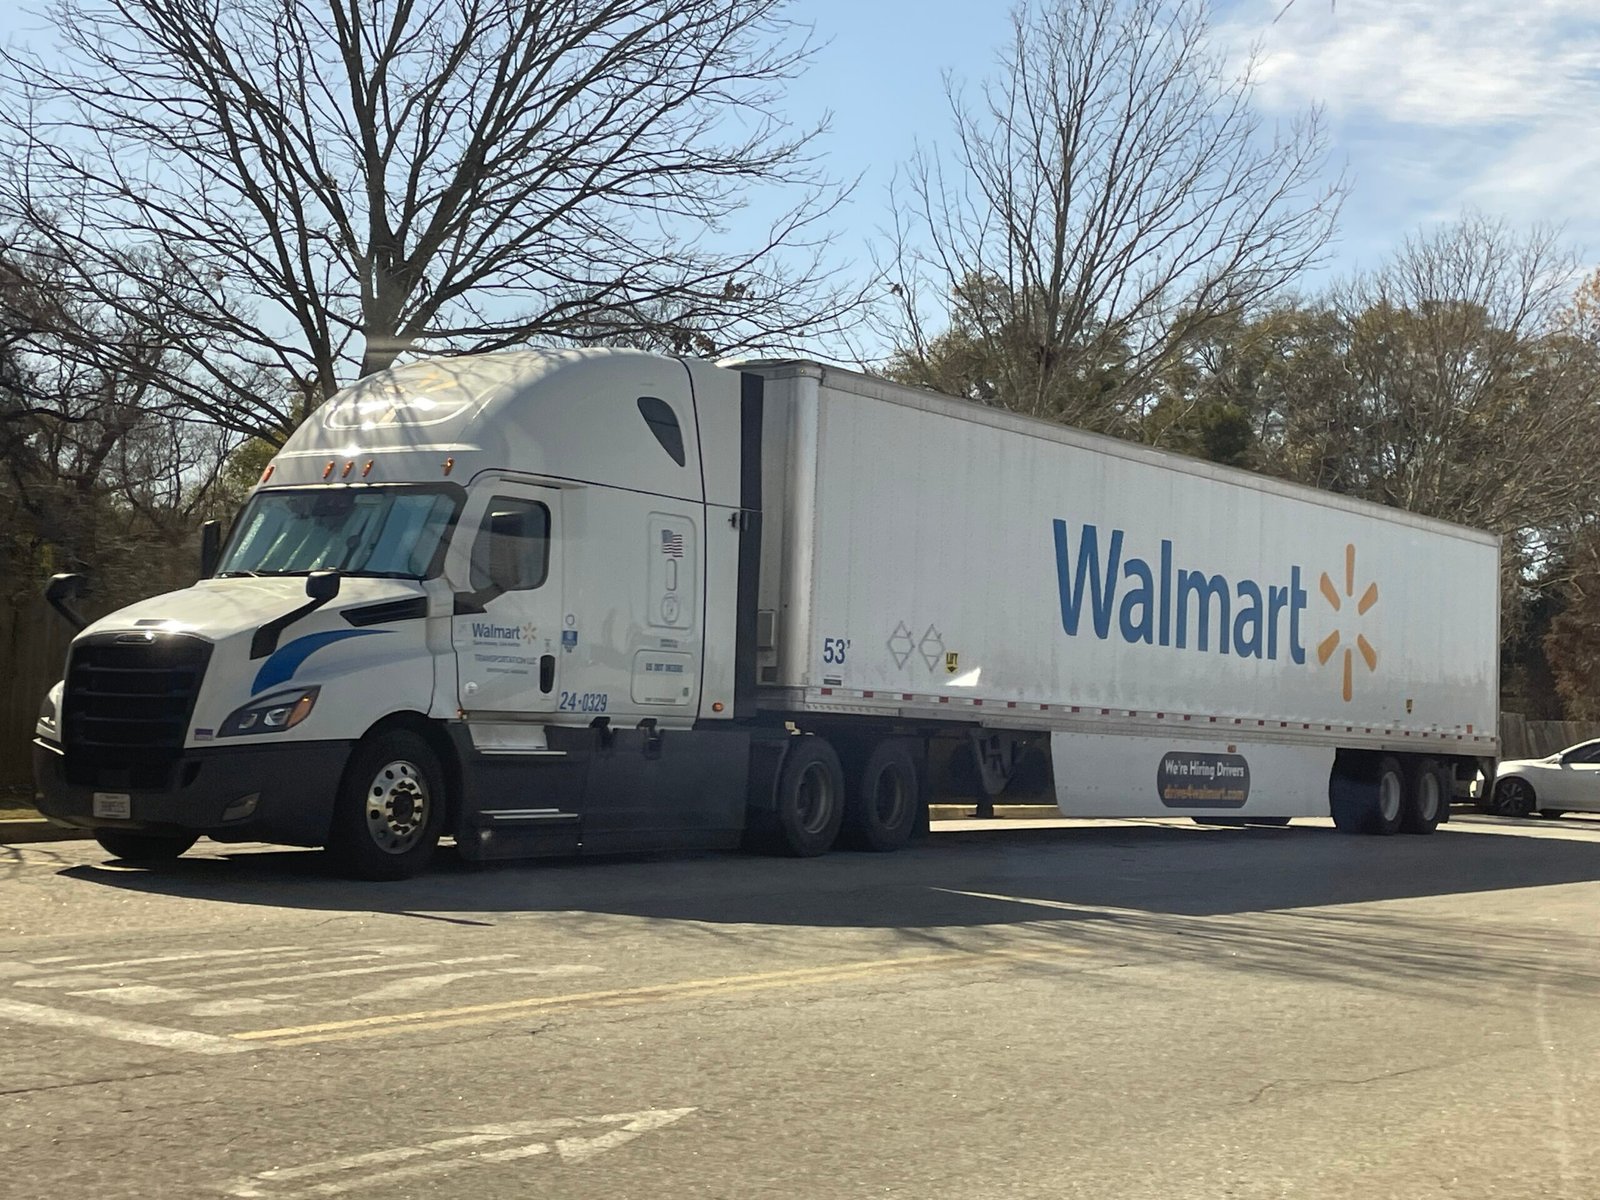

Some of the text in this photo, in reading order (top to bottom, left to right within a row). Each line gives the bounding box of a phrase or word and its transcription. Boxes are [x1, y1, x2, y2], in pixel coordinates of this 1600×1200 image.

[1053, 519, 1307, 664] Walmart
[472, 623, 520, 640] Walmart
[1165, 760, 1244, 780] We're Hiring Drivers
